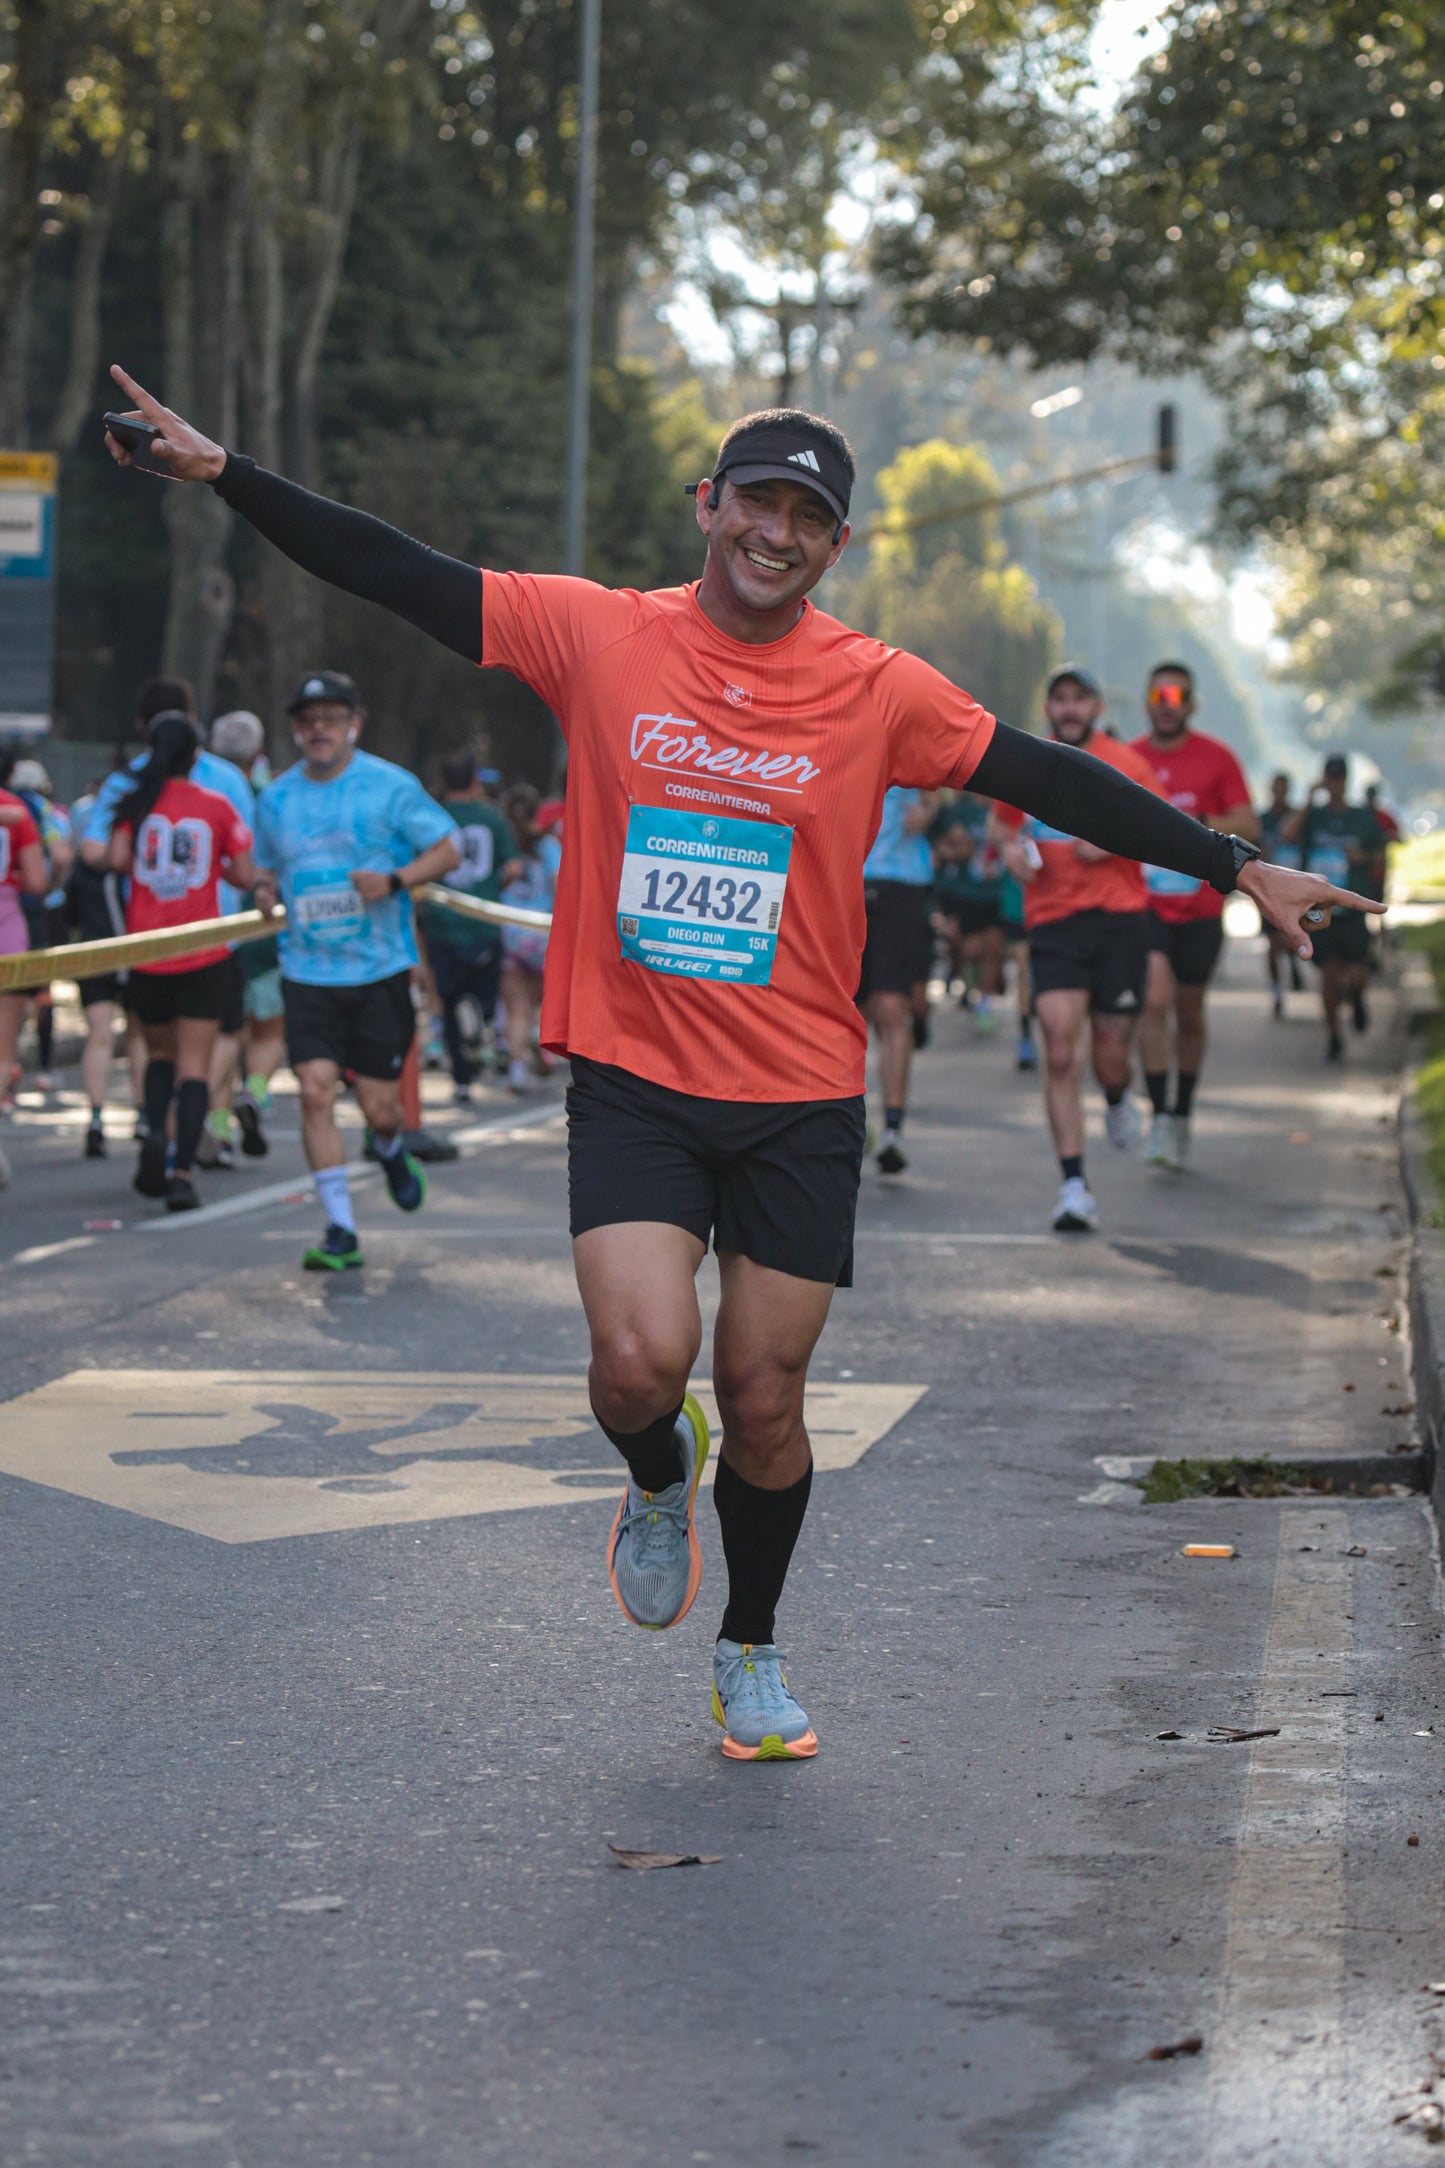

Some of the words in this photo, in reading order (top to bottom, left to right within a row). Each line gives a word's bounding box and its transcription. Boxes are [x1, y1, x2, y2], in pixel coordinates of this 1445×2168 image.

[630, 712, 821, 784] Forever
[664, 782, 771, 815] CORREMITIERRA
[646, 836, 769, 866] CORREMITIERRA
[640, 868, 762, 925] 12432
[667, 926, 700, 943] DIEGO
[701, 930, 725, 946] RUN
[747, 936, 770, 951] 15K
